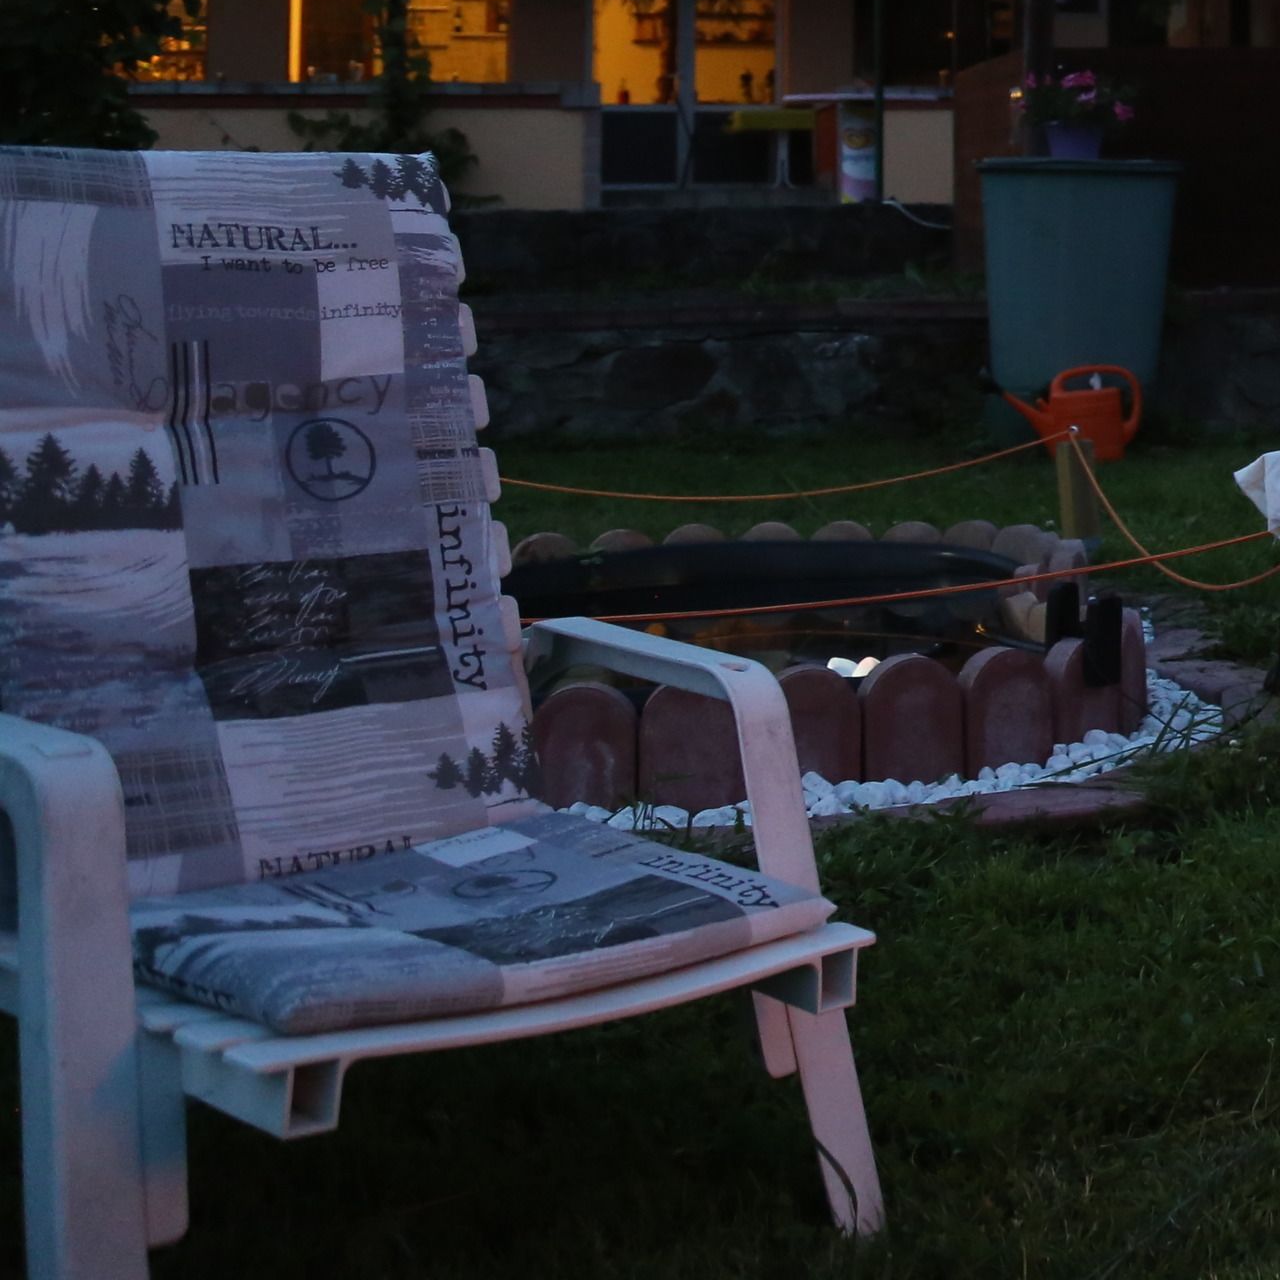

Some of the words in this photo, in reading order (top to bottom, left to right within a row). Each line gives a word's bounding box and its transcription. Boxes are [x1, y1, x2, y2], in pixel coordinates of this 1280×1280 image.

[171, 223, 357, 251] NATURAL...
[201, 255, 211, 271] I
[221, 257, 272, 272] want
[282, 257, 303, 274] to
[313, 258, 336, 273] be
[347, 255, 389, 271] free
[436, 504, 487, 691] infinity
